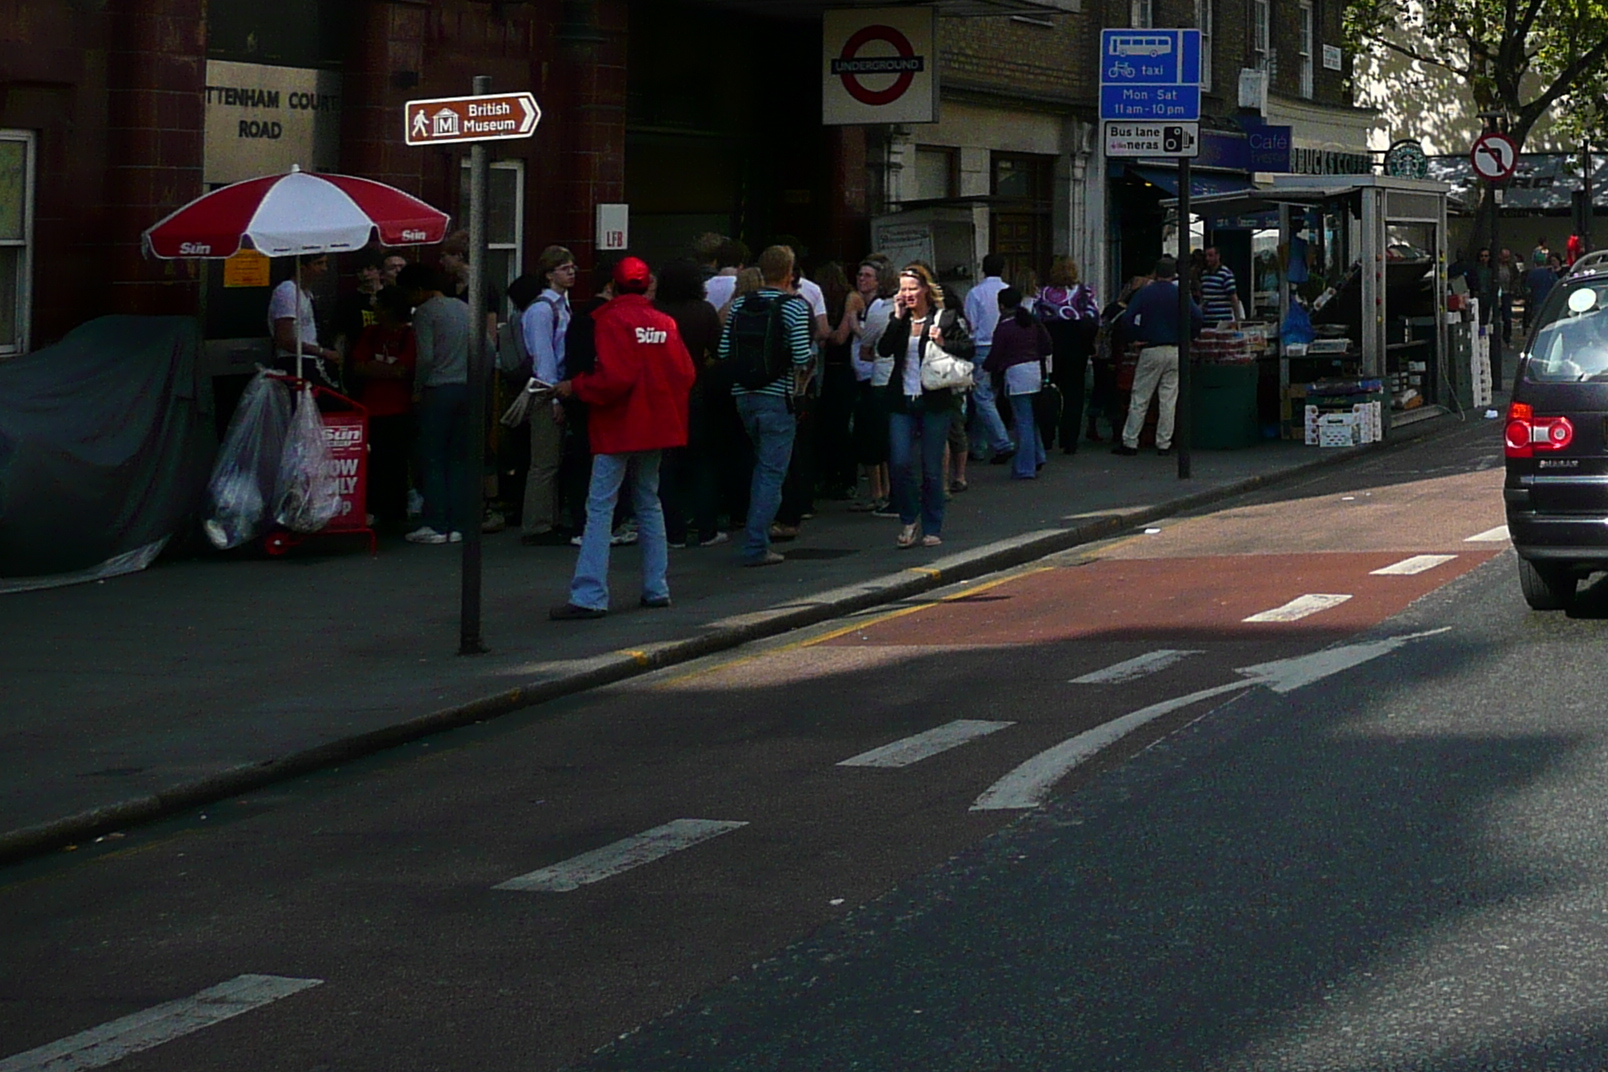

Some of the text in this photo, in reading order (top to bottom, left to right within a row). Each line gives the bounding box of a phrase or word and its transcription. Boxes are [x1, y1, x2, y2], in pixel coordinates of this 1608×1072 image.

[835, 59, 919, 71] UNDERGROUND
[1142, 65, 1164, 76] taxi
[206, 87, 340, 111] TTENHAM COURT
[1123, 89, 1178, 100] Mon Sat
[468, 102, 511, 117] British
[239, 120, 282, 138] ROAD
[463, 119, 516, 133] Museum
[1110, 127, 1160, 137] Bus lane
[606, 231, 623, 247] LFB
